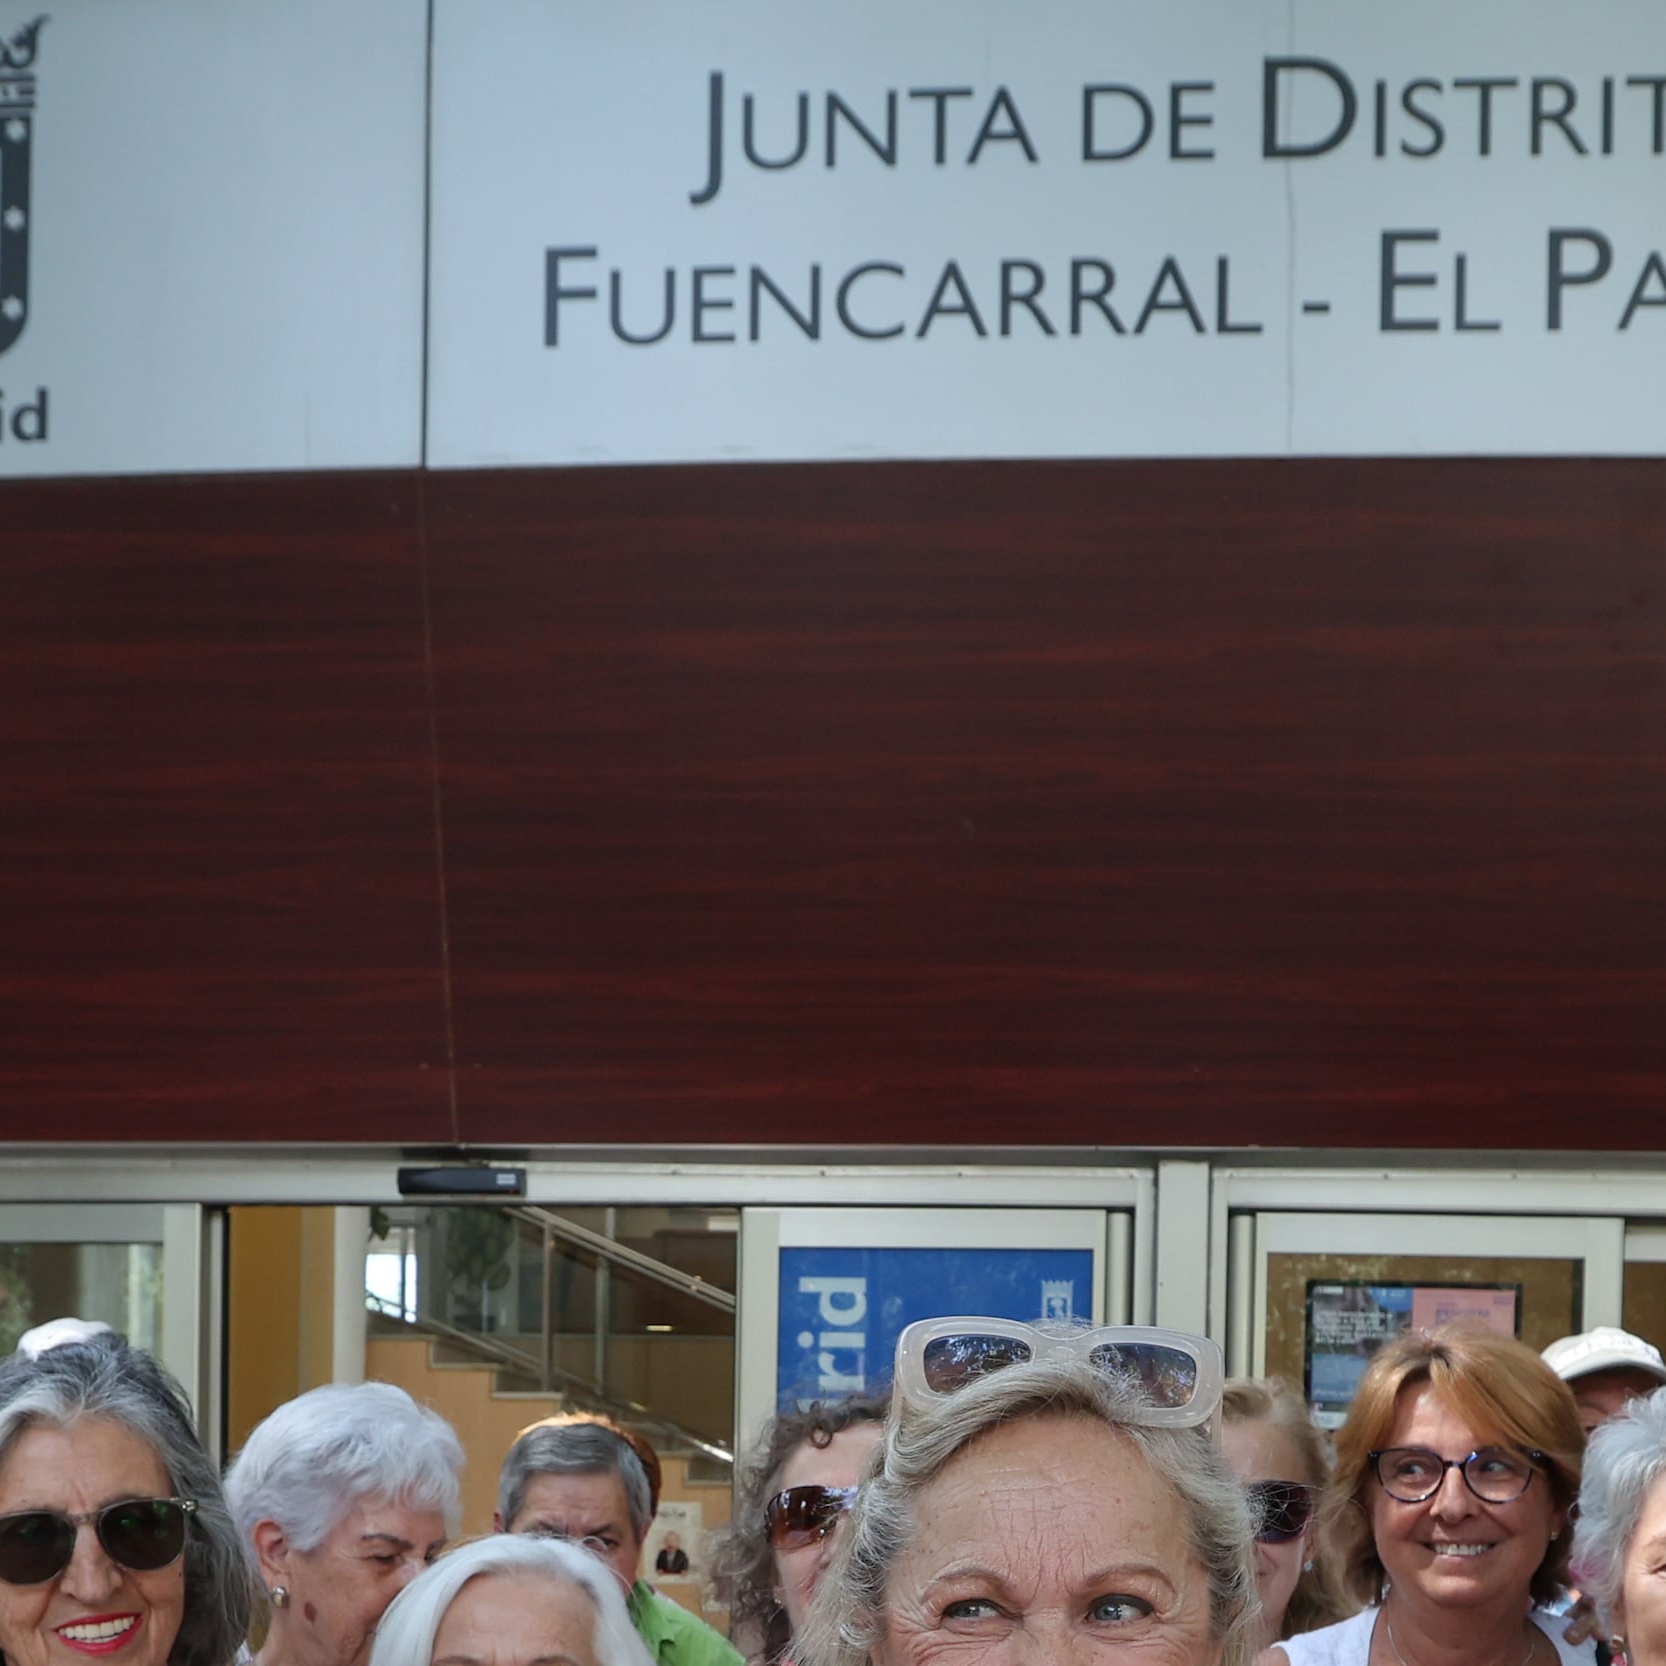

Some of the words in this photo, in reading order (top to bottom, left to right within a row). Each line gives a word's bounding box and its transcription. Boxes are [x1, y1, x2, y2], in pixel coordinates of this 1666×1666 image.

[688, 70, 1039, 208] JUNTA
[1081, 81, 1216, 163] DE
[543, 244, 1266, 349] FUENCARRAL
[1300, 300, 1333, 316] -
[1377, 228, 1503, 333] EL
